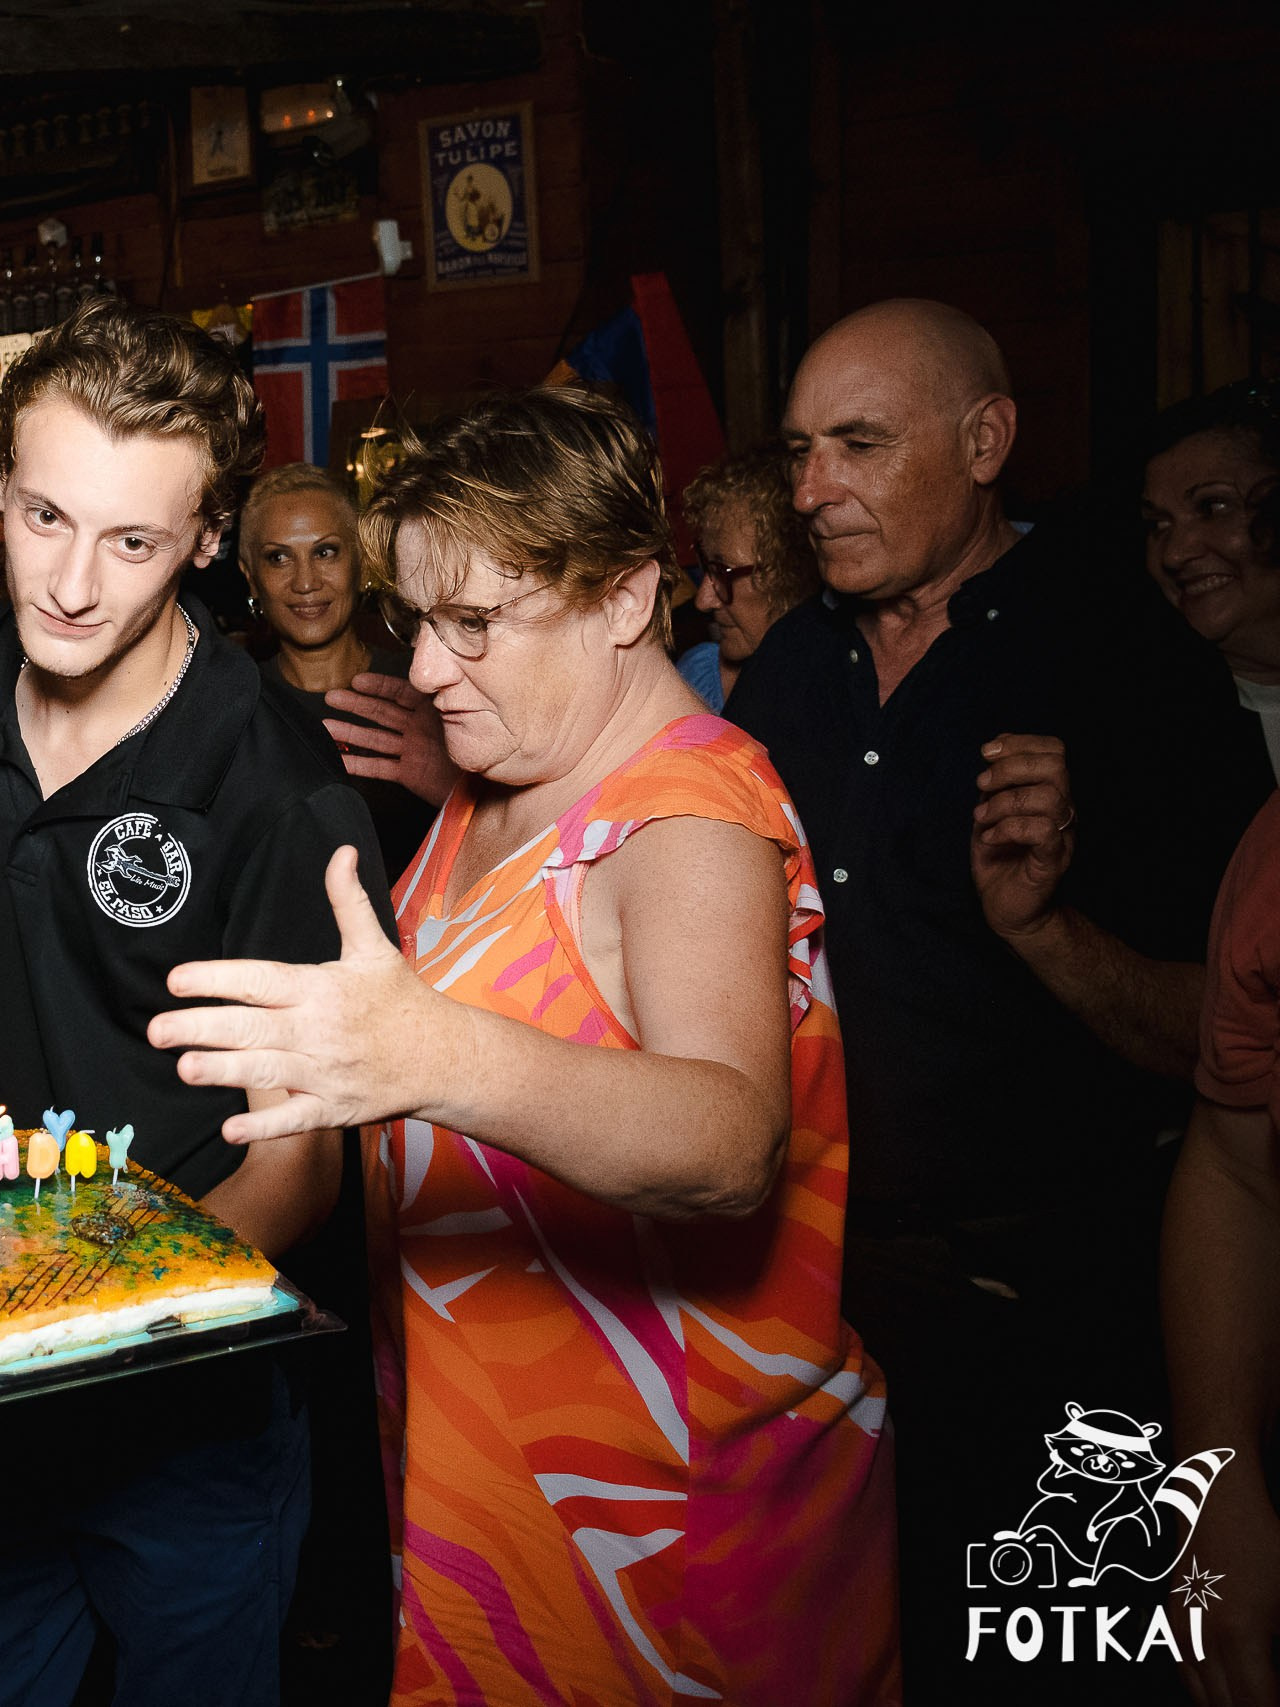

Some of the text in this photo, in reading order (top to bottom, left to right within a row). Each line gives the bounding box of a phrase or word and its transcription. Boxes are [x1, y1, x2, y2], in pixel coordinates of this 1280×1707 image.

[439, 120, 511, 148] SAVON
[434, 141, 519, 167] TULIPE
[114, 820, 183, 875] CAFE BAR
[98, 880, 154, 919] EL PASO
